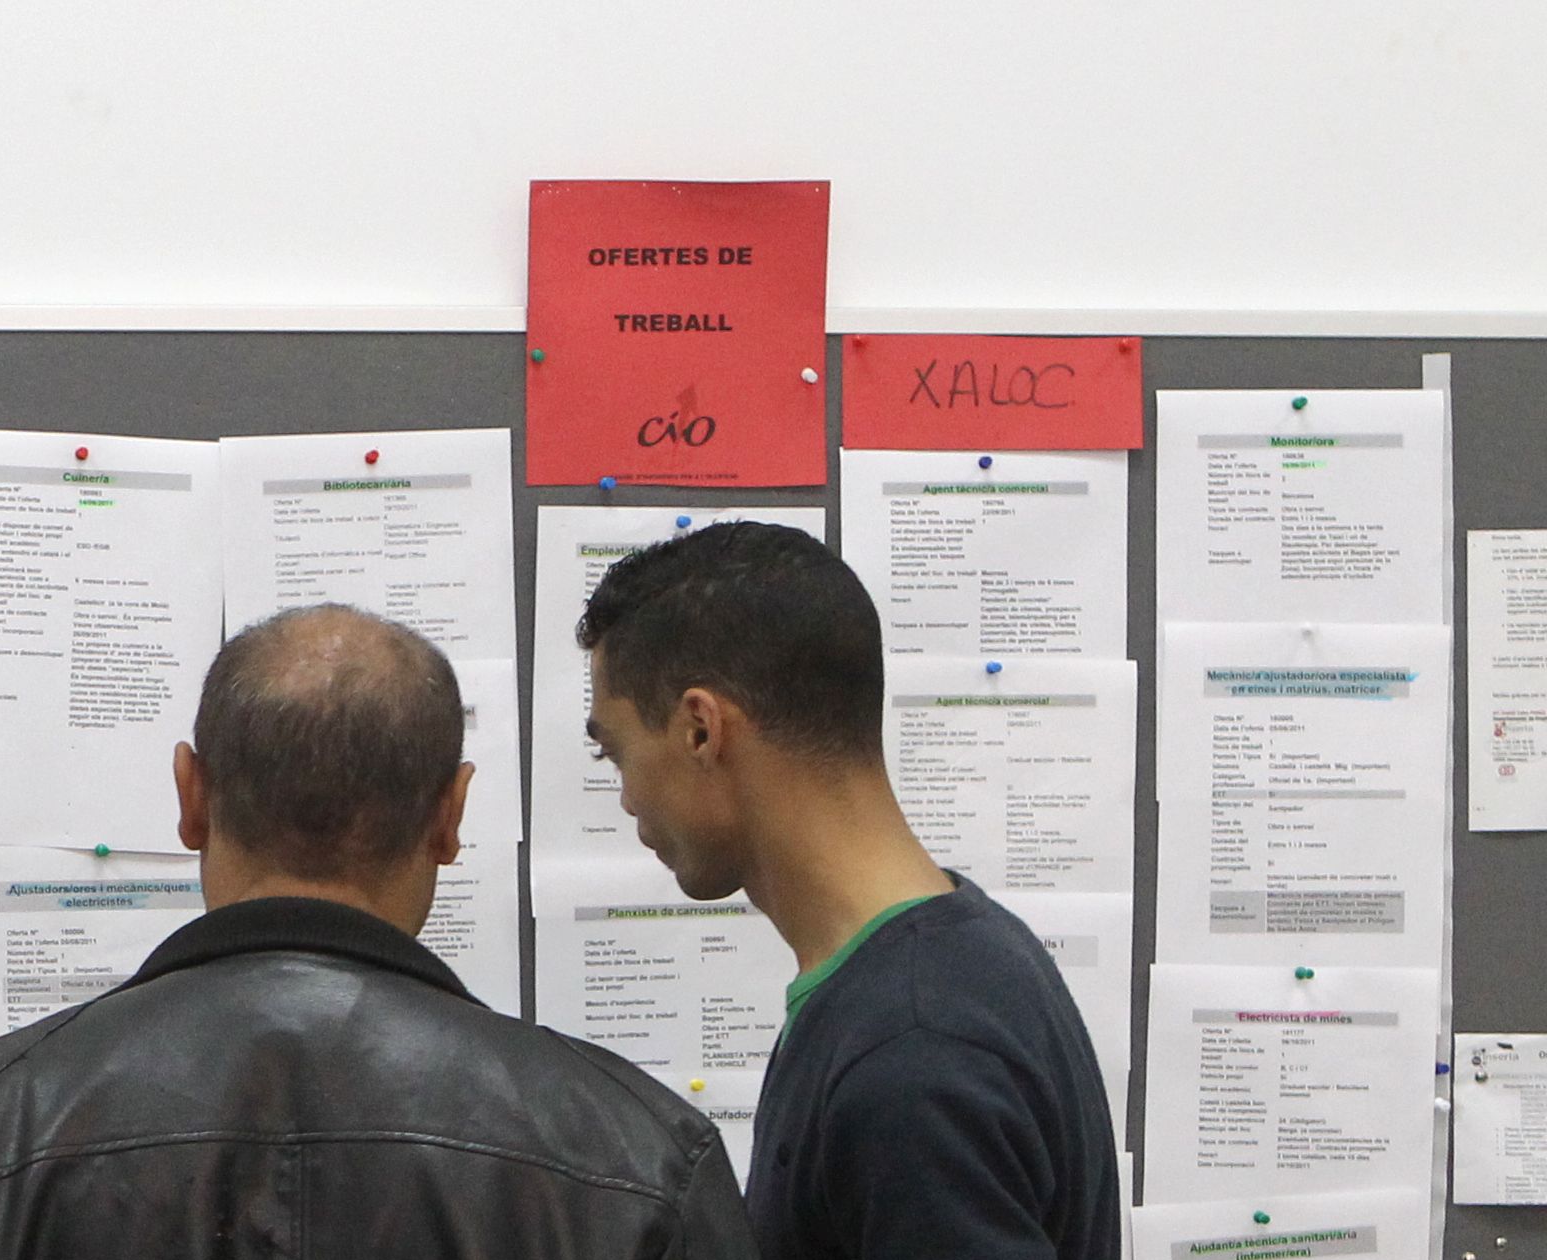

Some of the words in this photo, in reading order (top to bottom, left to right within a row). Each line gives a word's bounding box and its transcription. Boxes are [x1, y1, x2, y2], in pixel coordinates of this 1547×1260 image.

[588, 247, 708, 266] OFERTES
[718, 246, 752, 265] DE
[614, 314, 733, 332] TREBALL
[908, 358, 1077, 409] XALOC
[1271, 437, 1334, 446] Monitor/ora
[63, 471, 111, 485] Cuiner/a
[323, 478, 412, 491] Bibliotecari/ària
[923, 485, 954, 495] Agent
[956, 485, 996, 493] tècnic/a
[998, 485, 1048, 493] comercial
[1207, 670, 1263, 681] Mecànic/a
[1264, 670, 1337, 682] ajustador/ora
[1340, 670, 1406, 682] especialista
[935, 698, 963, 706] Agent
[965, 697, 1001, 705] tècnic/a
[9, 885, 97, 896] Ajustadors/ores
[100, 884, 104, 892] i
[107, 882, 191, 894] mecànics/ques
[66, 897, 133, 907] electricistes
[607, 907, 657, 917] Planxista
[660, 907, 674, 916] de
[677, 905, 747, 916] carrosseries
[1238, 1012, 1301, 1023] Electricista
[1303, 1013, 1317, 1023] de
[1319, 1014, 1353, 1025] mines
[1190, 1240, 1243, 1253] Ajudant/a
[1245, 1236, 1288, 1248] tècnic/a
[1291, 1230, 1358, 1243] sanitari/ària
